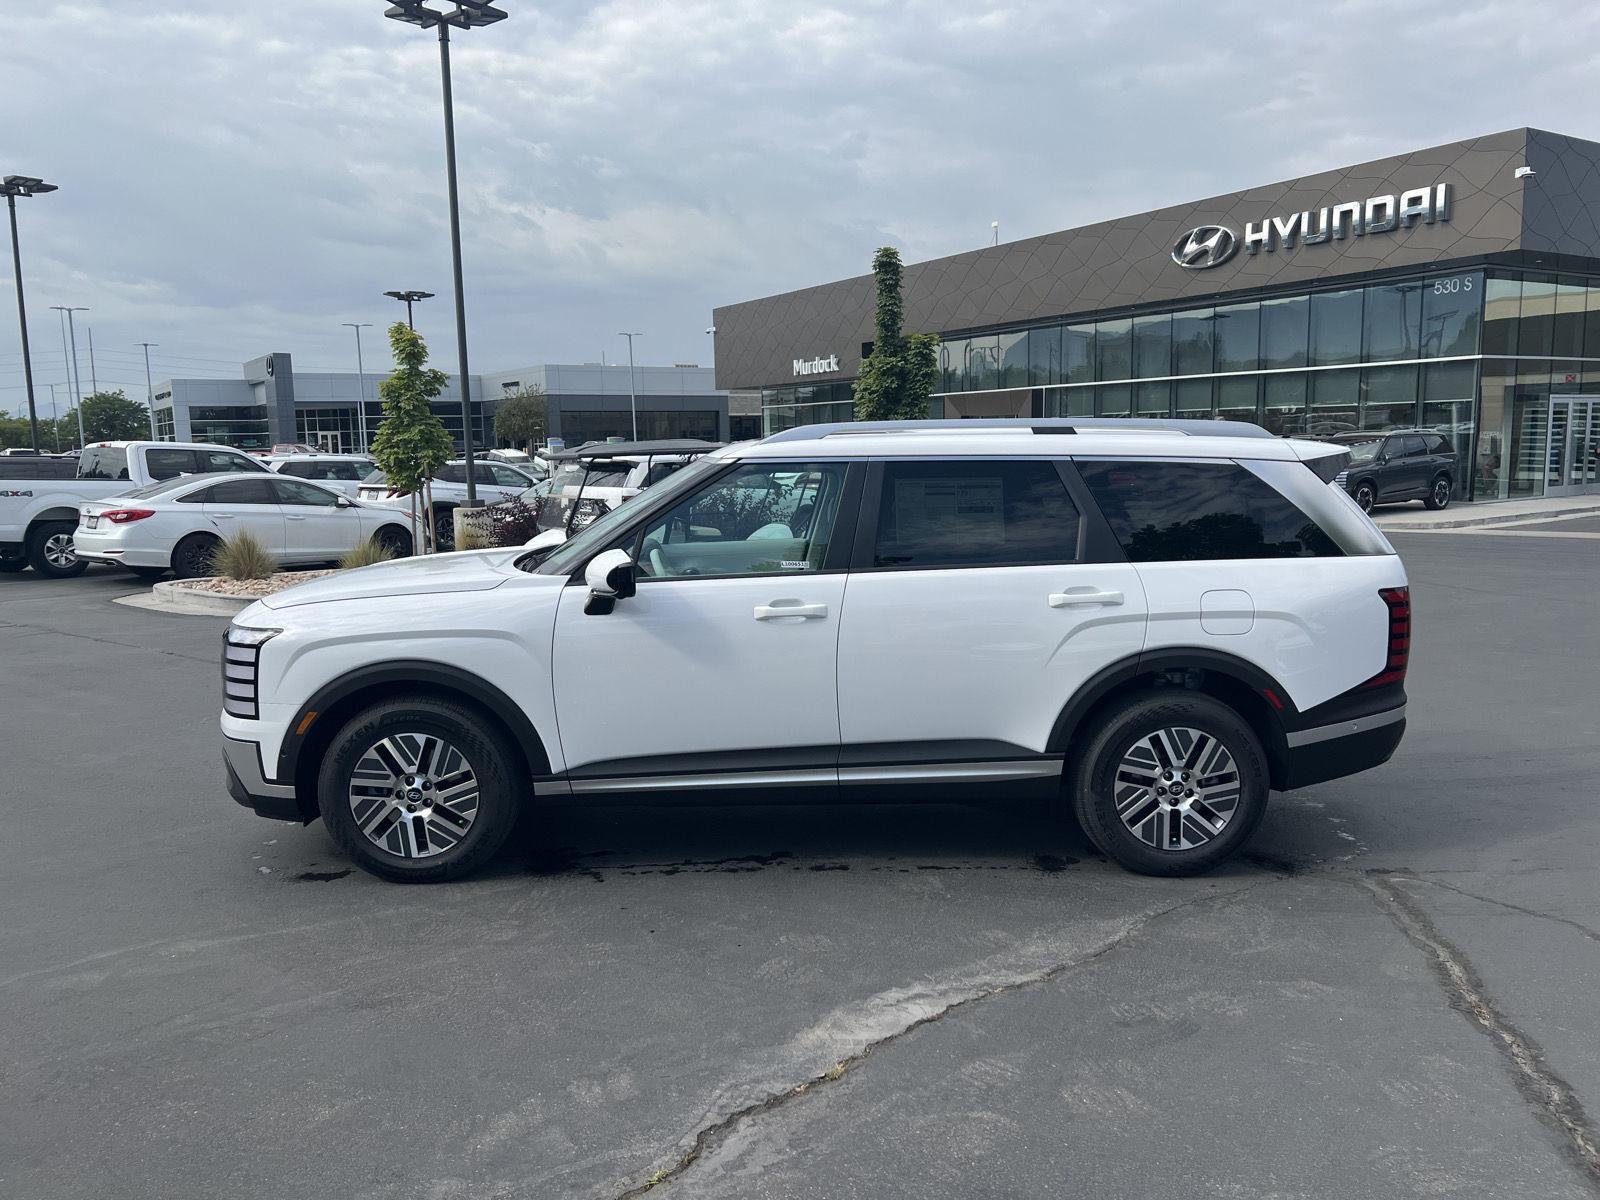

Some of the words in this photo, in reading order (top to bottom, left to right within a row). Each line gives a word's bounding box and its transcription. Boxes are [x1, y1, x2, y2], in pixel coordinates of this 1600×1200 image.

[1245, 183, 1450, 255] HYUNDAI
[1433, 278, 1460, 295] 530
[1463, 276, 1473, 291] S
[793, 354, 840, 376] Murdock
